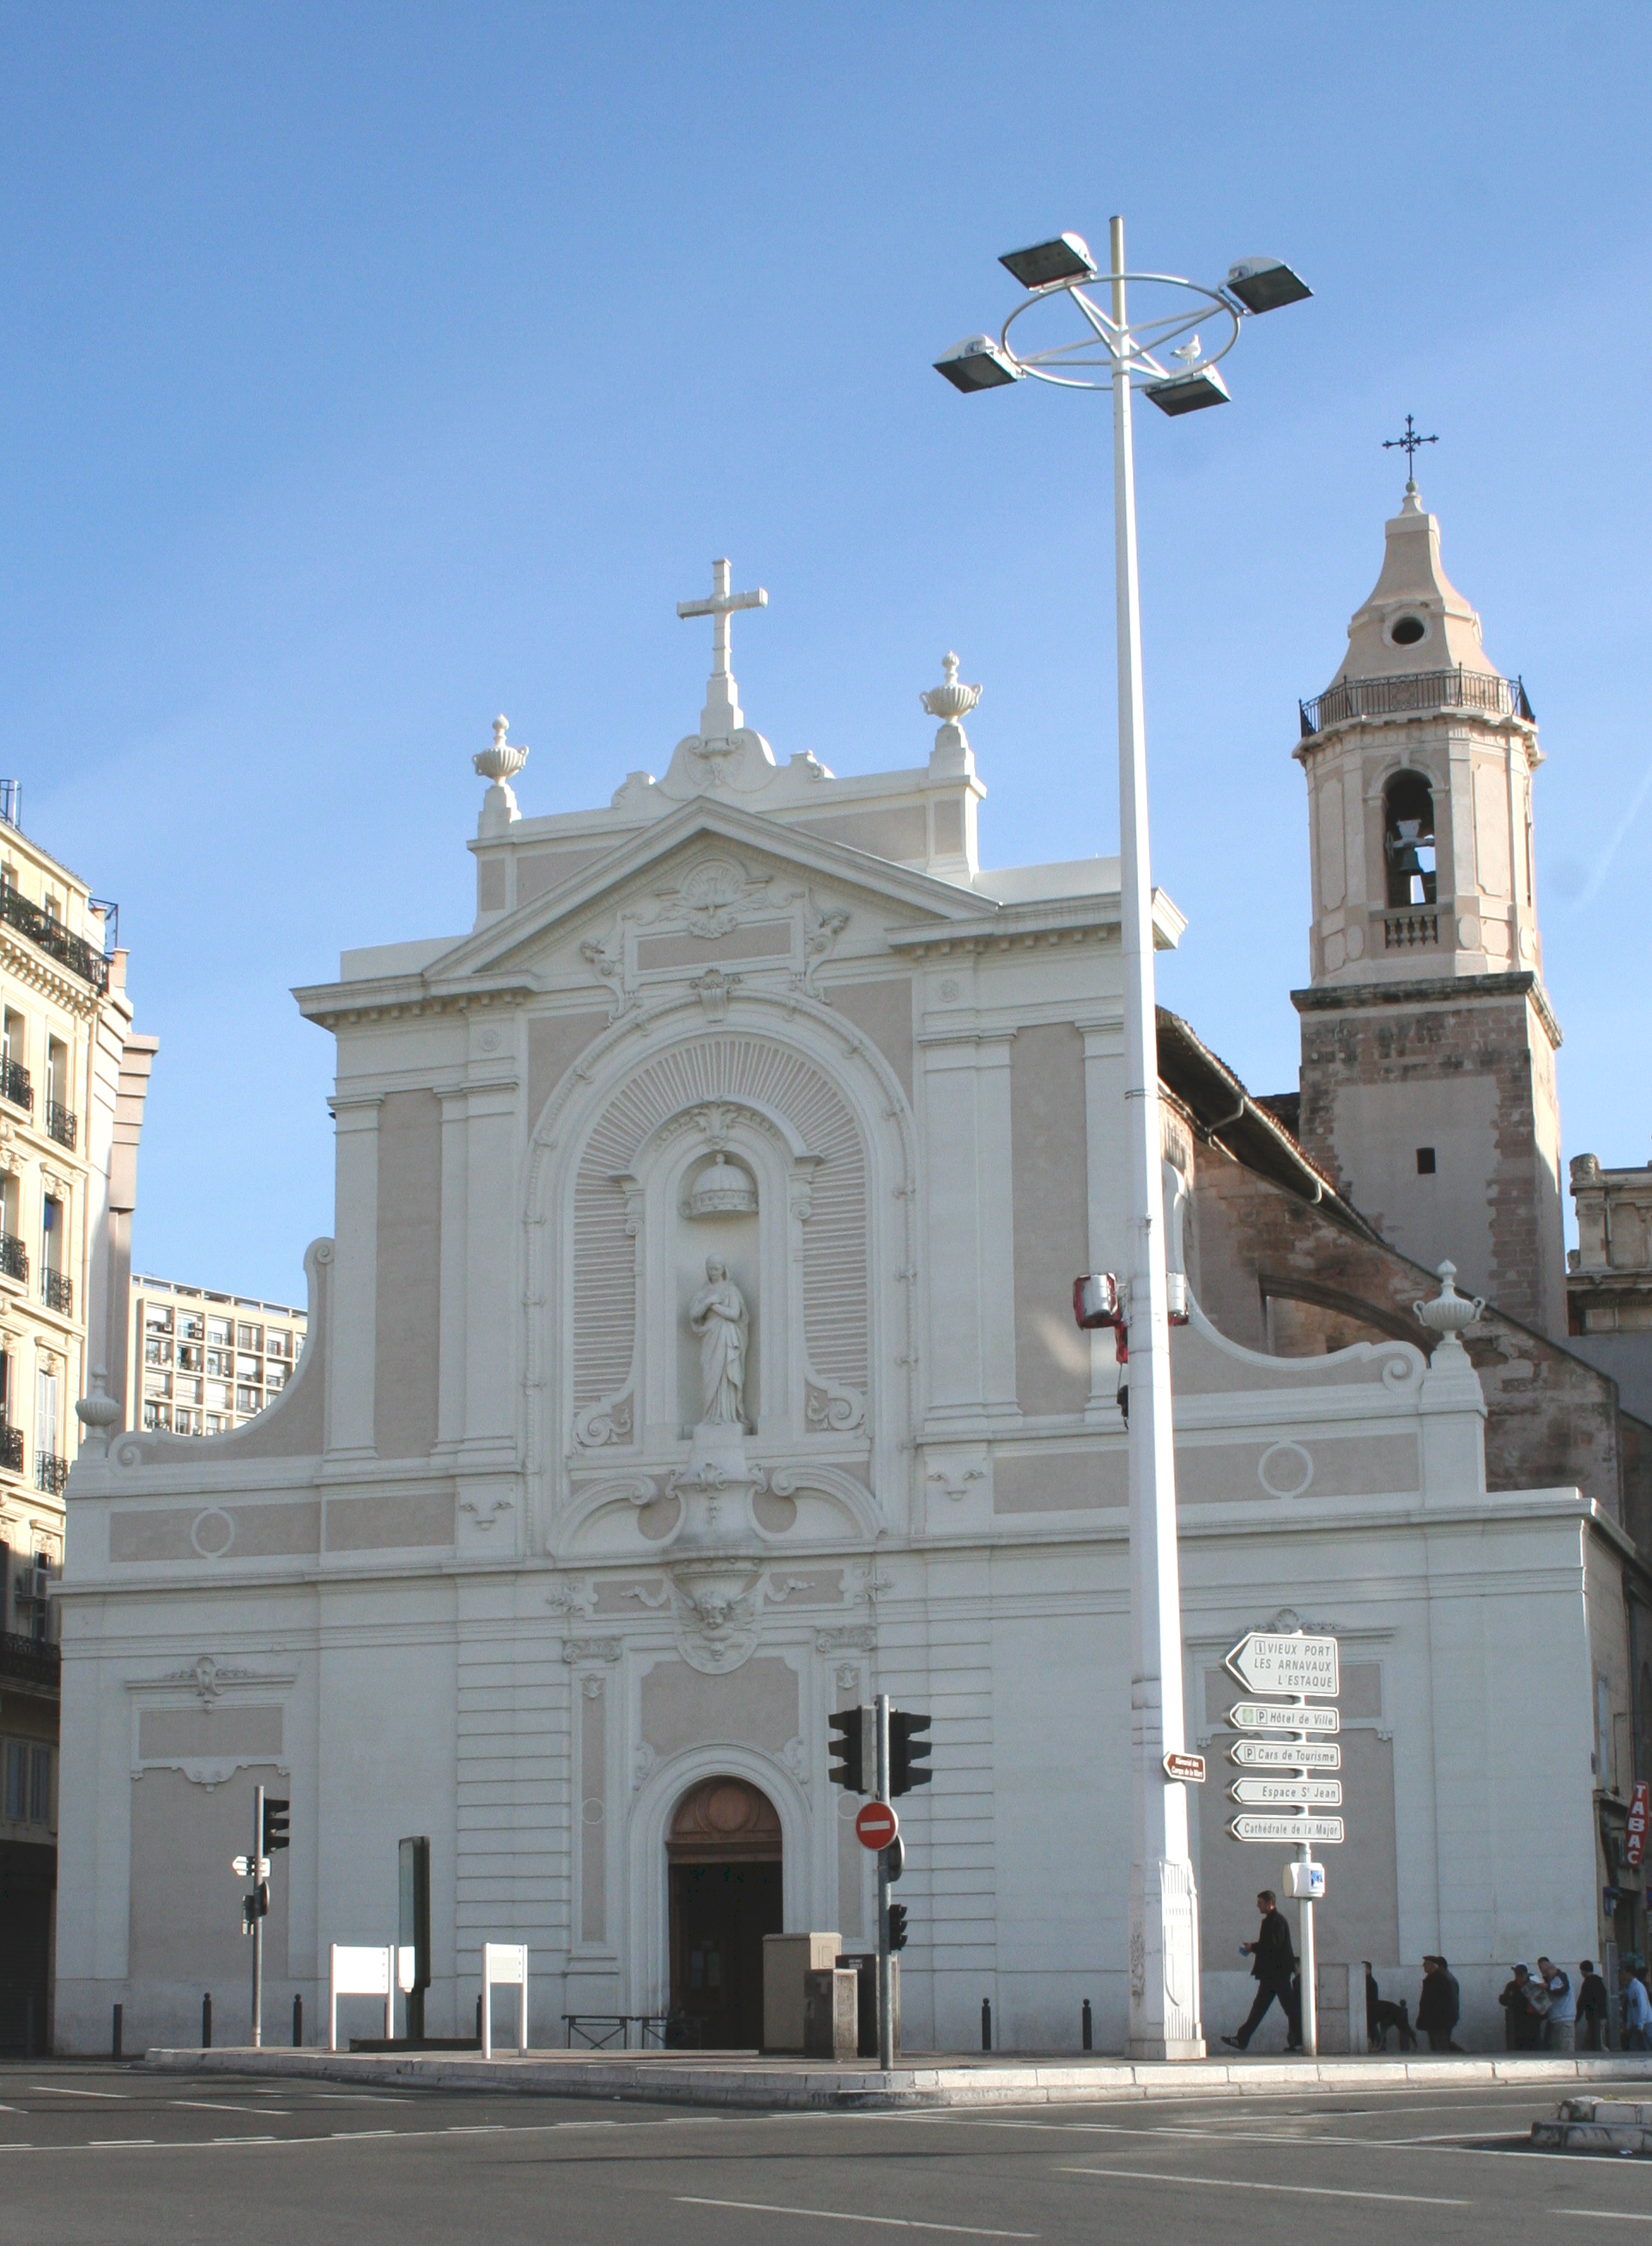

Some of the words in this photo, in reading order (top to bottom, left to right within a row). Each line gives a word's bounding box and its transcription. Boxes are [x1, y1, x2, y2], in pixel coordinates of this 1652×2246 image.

[1268, 1643, 1298, 1656] VIEUX
[1304, 1644, 1331, 1656] PORT
[1254, 1657, 1271, 1669] LES
[1278, 1659, 1331, 1673] ARNAVAUX
[1278, 1674, 1332, 1688] L'ESTAQUE
[1269, 1711, 1295, 1724] Hôtel
[1298, 1713, 1310, 1724] de
[1313, 1714, 1334, 1726] Ville
[1258, 1748, 1279, 1760] Cars
[1281, 1749, 1292, 1760] de
[1296, 1749, 1335, 1762] Tourisme
[1262, 1785, 1297, 1800] Espace
[1313, 1787, 1336, 1799] Jean
[1244, 1822, 1287, 1835] Cathédrale
[1291, 1824, 1300, 1835] de
[1304, 1824, 1312, 1835] la
[1316, 1824, 1338, 1837] Major
[1627, 1784, 1646, 1865] TABAC
